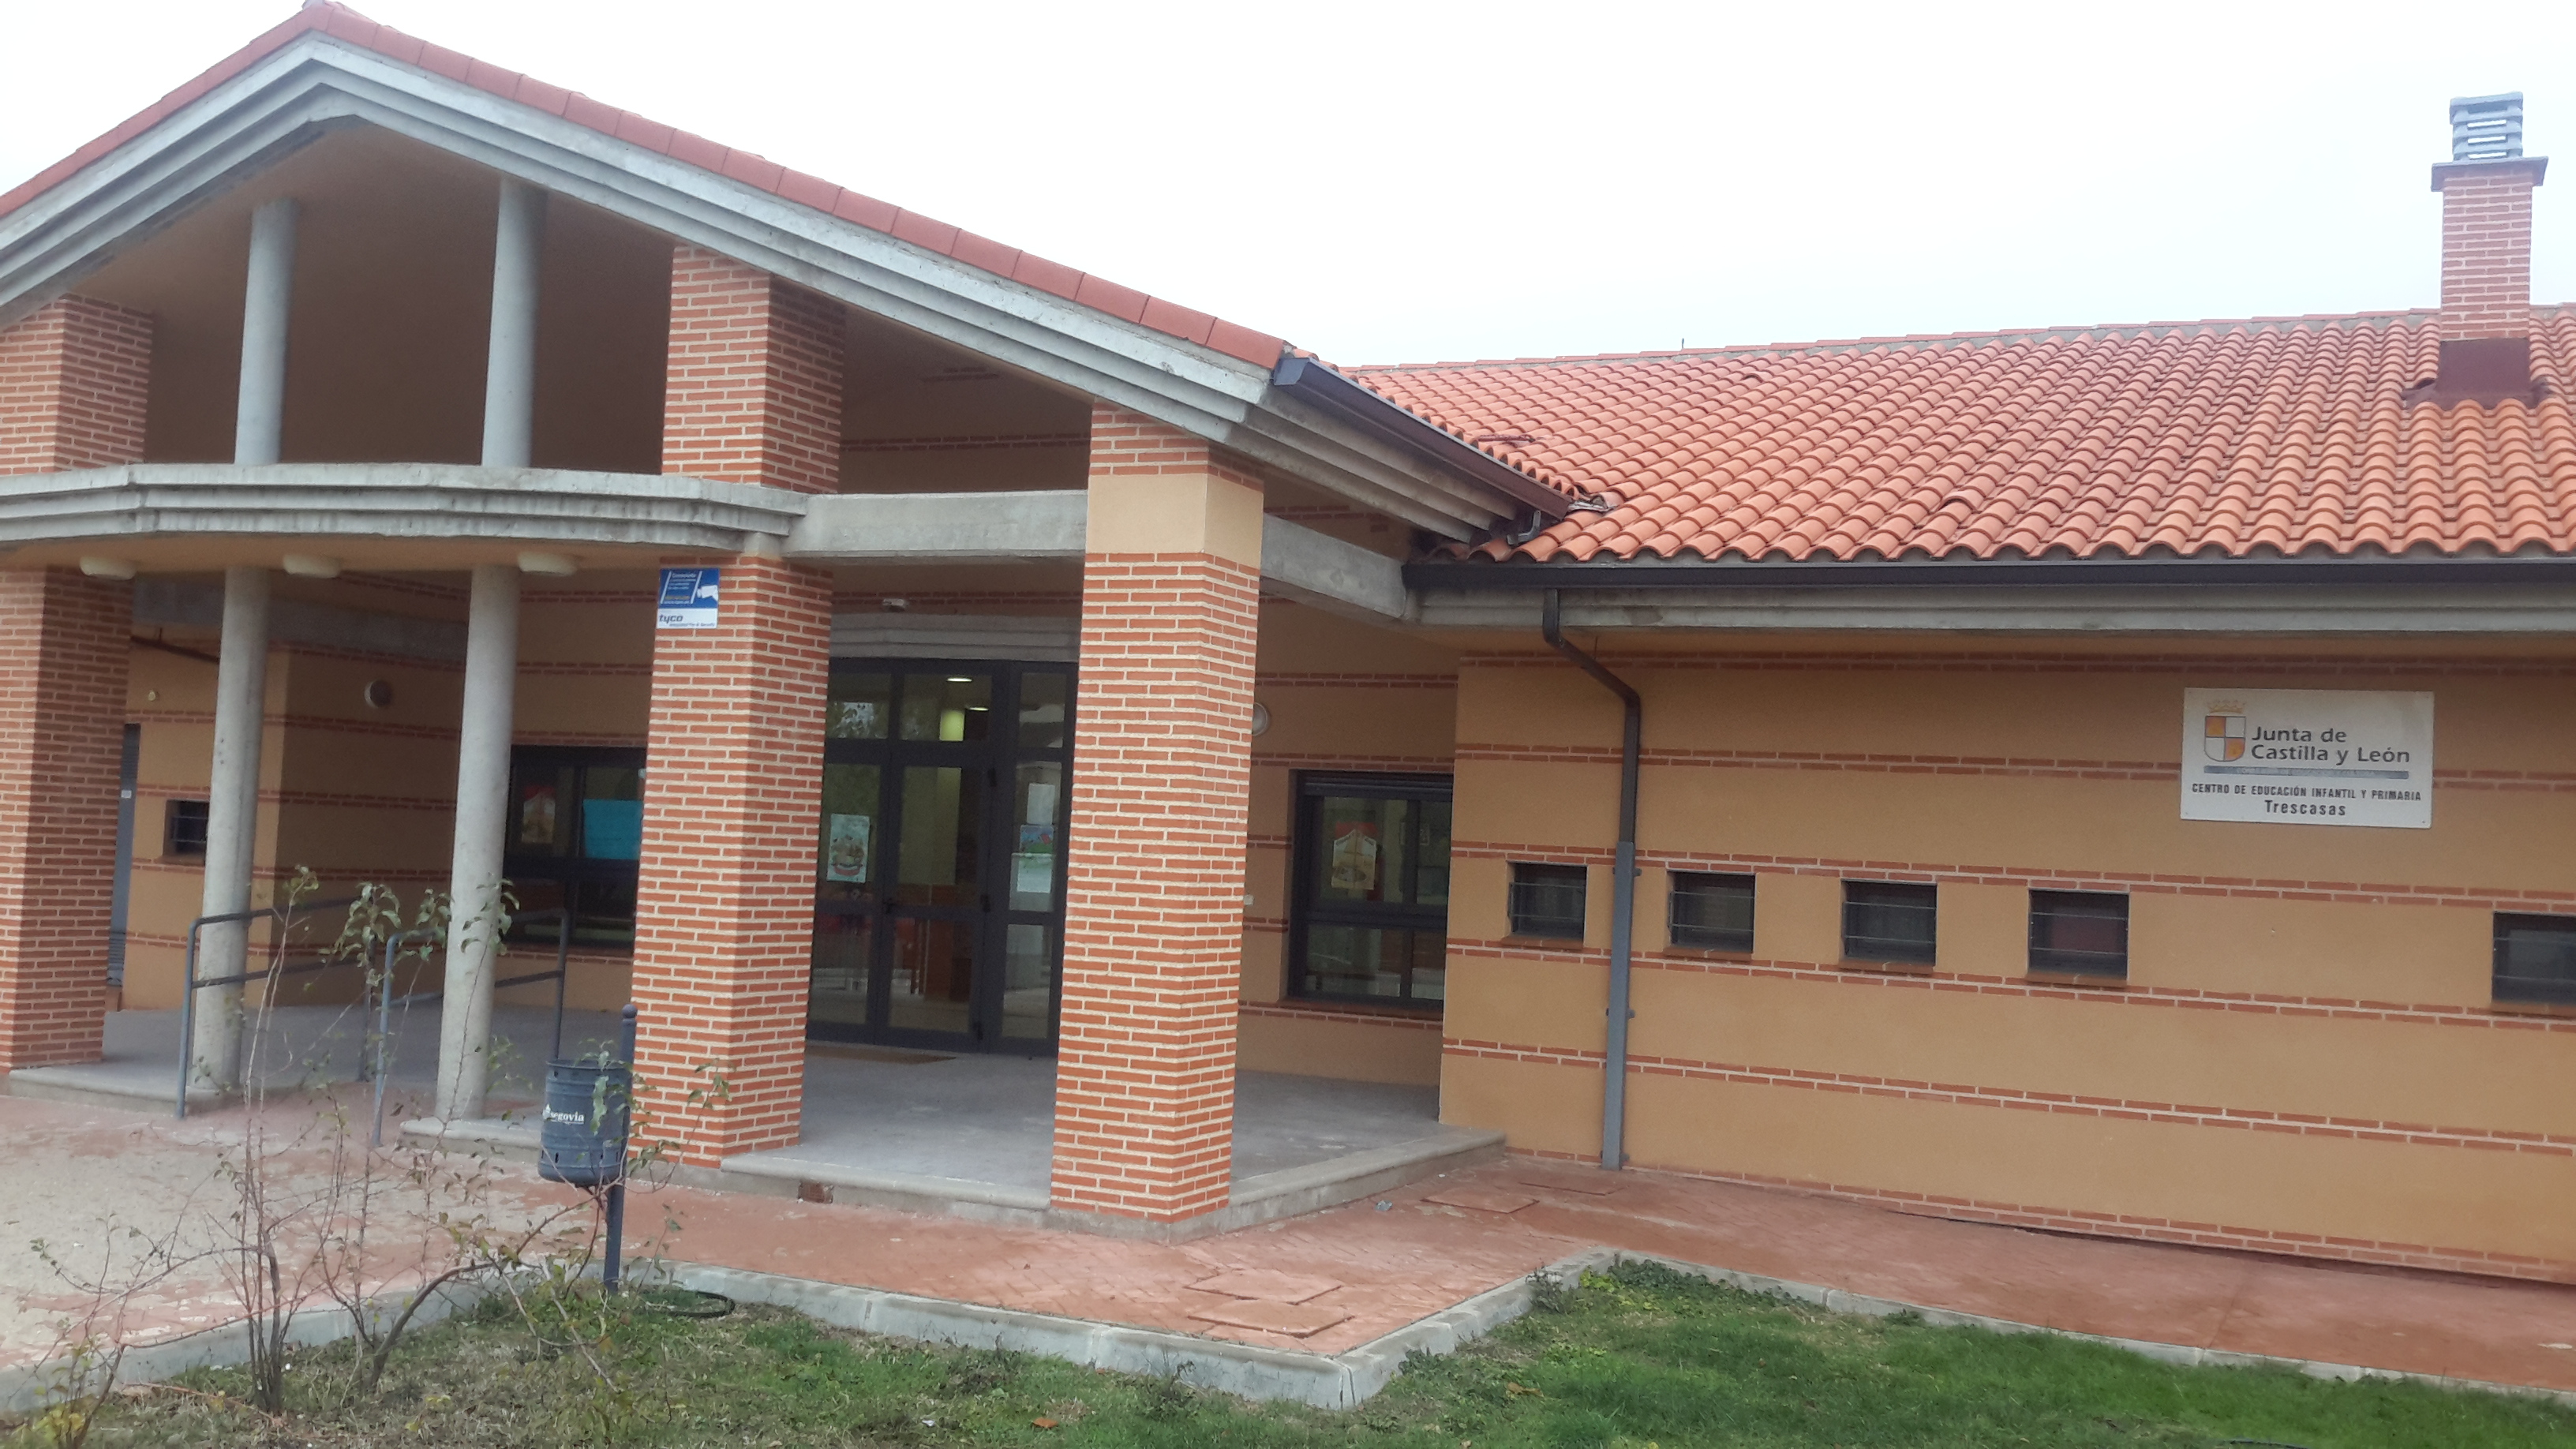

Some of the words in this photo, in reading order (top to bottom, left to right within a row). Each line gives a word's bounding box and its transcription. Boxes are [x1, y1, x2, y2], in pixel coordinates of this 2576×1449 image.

[659, 614, 683, 623] tyco
[2252, 726, 2312, 742] Junta
[2320, 728, 2347, 743] de
[2251, 744, 2328, 761] Castilla
[2335, 749, 2349, 766] y
[2357, 747, 2410, 763] León
[2192, 783, 2230, 794] CENTRO
[2234, 784, 2246, 795] DE
[2251, 785, 2307, 796] EDUCACIÓN
[2312, 788, 2356, 799] INFANTIL
[2361, 789, 2367, 799] Y
[2371, 789, 2421, 801] PRIMARIA
[2264, 799, 2346, 816] Trescasas
